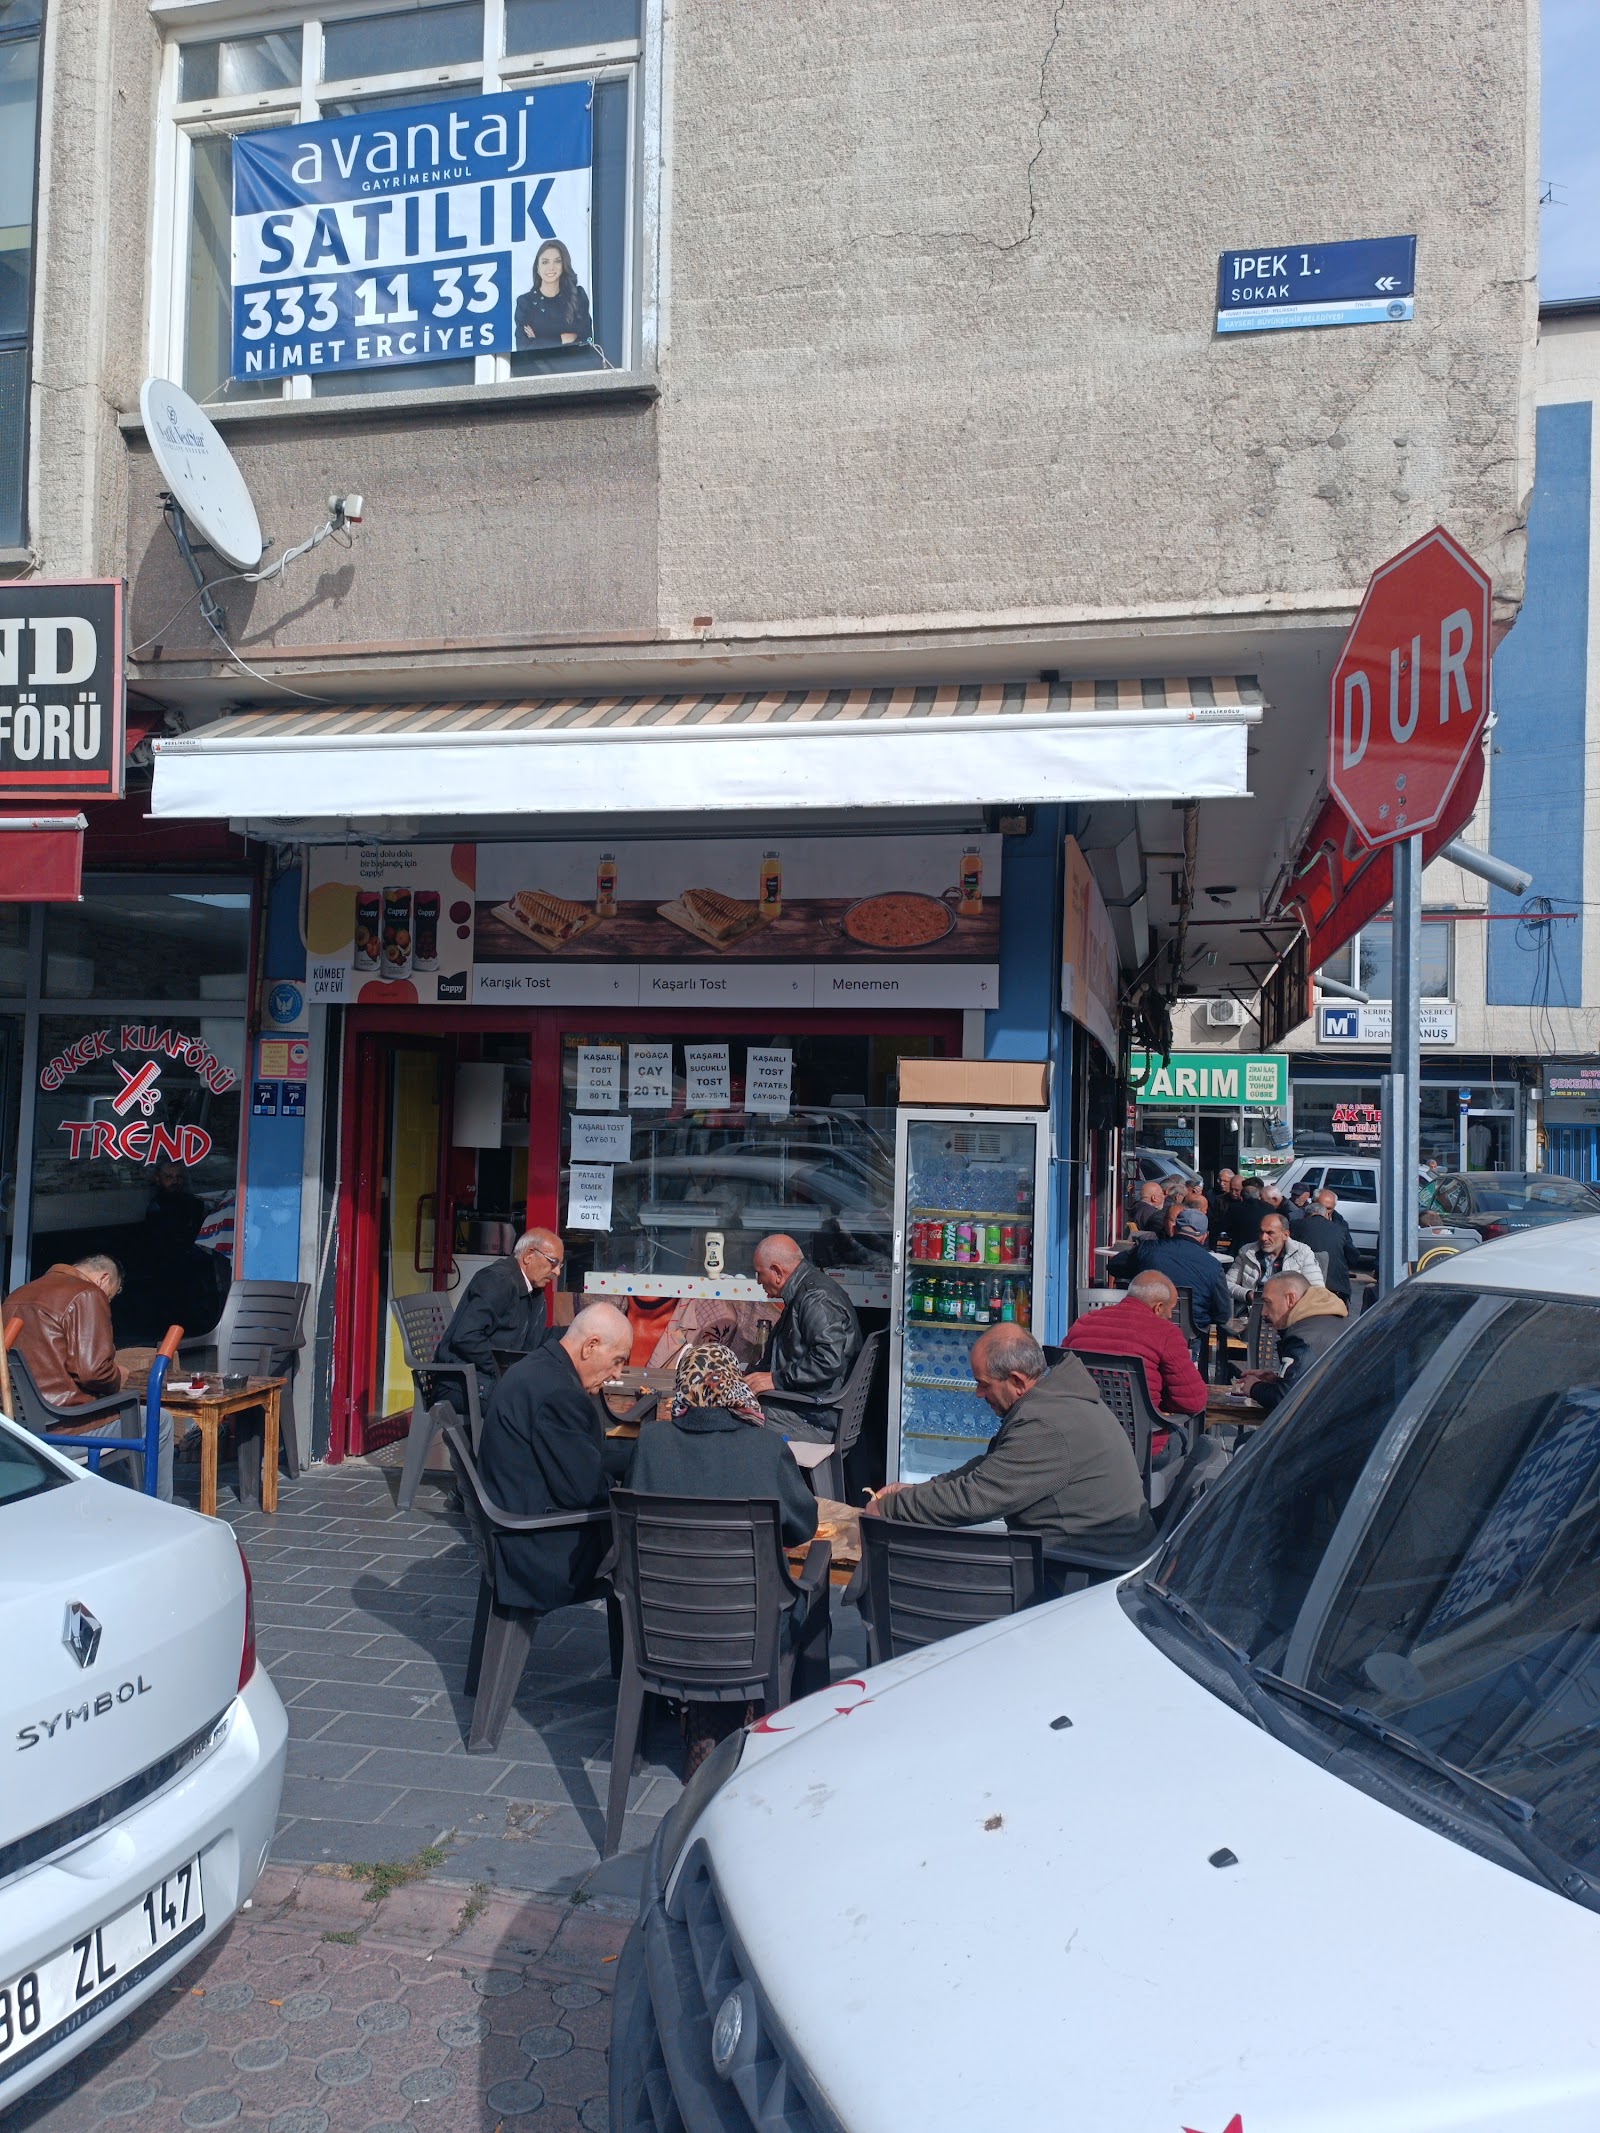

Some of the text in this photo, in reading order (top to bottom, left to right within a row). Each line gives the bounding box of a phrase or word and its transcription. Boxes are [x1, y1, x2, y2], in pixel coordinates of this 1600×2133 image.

[291, 96, 534, 184] avantaj
[362, 169, 472, 192] GAYRİMENKUL
[259, 178, 557, 274] SATILIK
[1233, 254, 1288, 280] İPEK
[1231, 284, 1290, 301] SOKAK
[242, 262, 500, 341] 333 11 33
[1225, 312, 1344, 328] KAYSERİ BÜYÜKŞEHİR BELEDİYESİ
[245, 323, 496, 373] NİMET ERCİYES
[1342, 607, 1473, 771] DUR
[379, 850, 396, 858] dolu
[397, 850, 413, 858] dolu
[404, 860, 418, 868] için
[360, 869, 384, 877] Cappy!
[360, 909, 378, 917] Cappy
[387, 908, 408, 916] Cappy
[417, 909, 436, 917] Cappy
[313, 965, 345, 979] KÜMBET
[314, 980, 343, 995] ÇAY EVİ
[440, 984, 464, 993] Cappy
[480, 977, 551, 989] Karışık Tost
[652, 978, 727, 991] Kaşarlı Tost
[832, 978, 899, 990] Menemen
[40, 1029, 116, 1091] ERKEK
[121, 1025, 237, 1095] KUAFÖRÜ
[583, 1053, 620, 1062] KAŞARLI
[634, 1051, 669, 1060] POĞAÇA
[690, 1052, 726, 1060] KAŞARLI
[638, 1066, 663, 1078] ÇAY
[1262, 1066, 1275, 1074] İLAÇ
[697, 1078, 723, 1086] TOST
[753, 1081, 788, 1089] PATATES
[1130, 1067, 1239, 1098] TARIM
[633, 1086, 669, 1096] 20 TL
[1249, 1090, 1273, 1098] GÜBRE
[1332, 1110, 1359, 1121] AK
[578, 1123, 606, 1131] KAŞARLI
[57, 1120, 212, 1167] TREND
[580, 1212, 590, 1220] 60
[944, 1223, 956, 1261] Sprite
[16, 1674, 152, 1751] SYMBOL
[73, 1926, 116, 2001] ZL
[142, 1863, 192, 1947] 147
